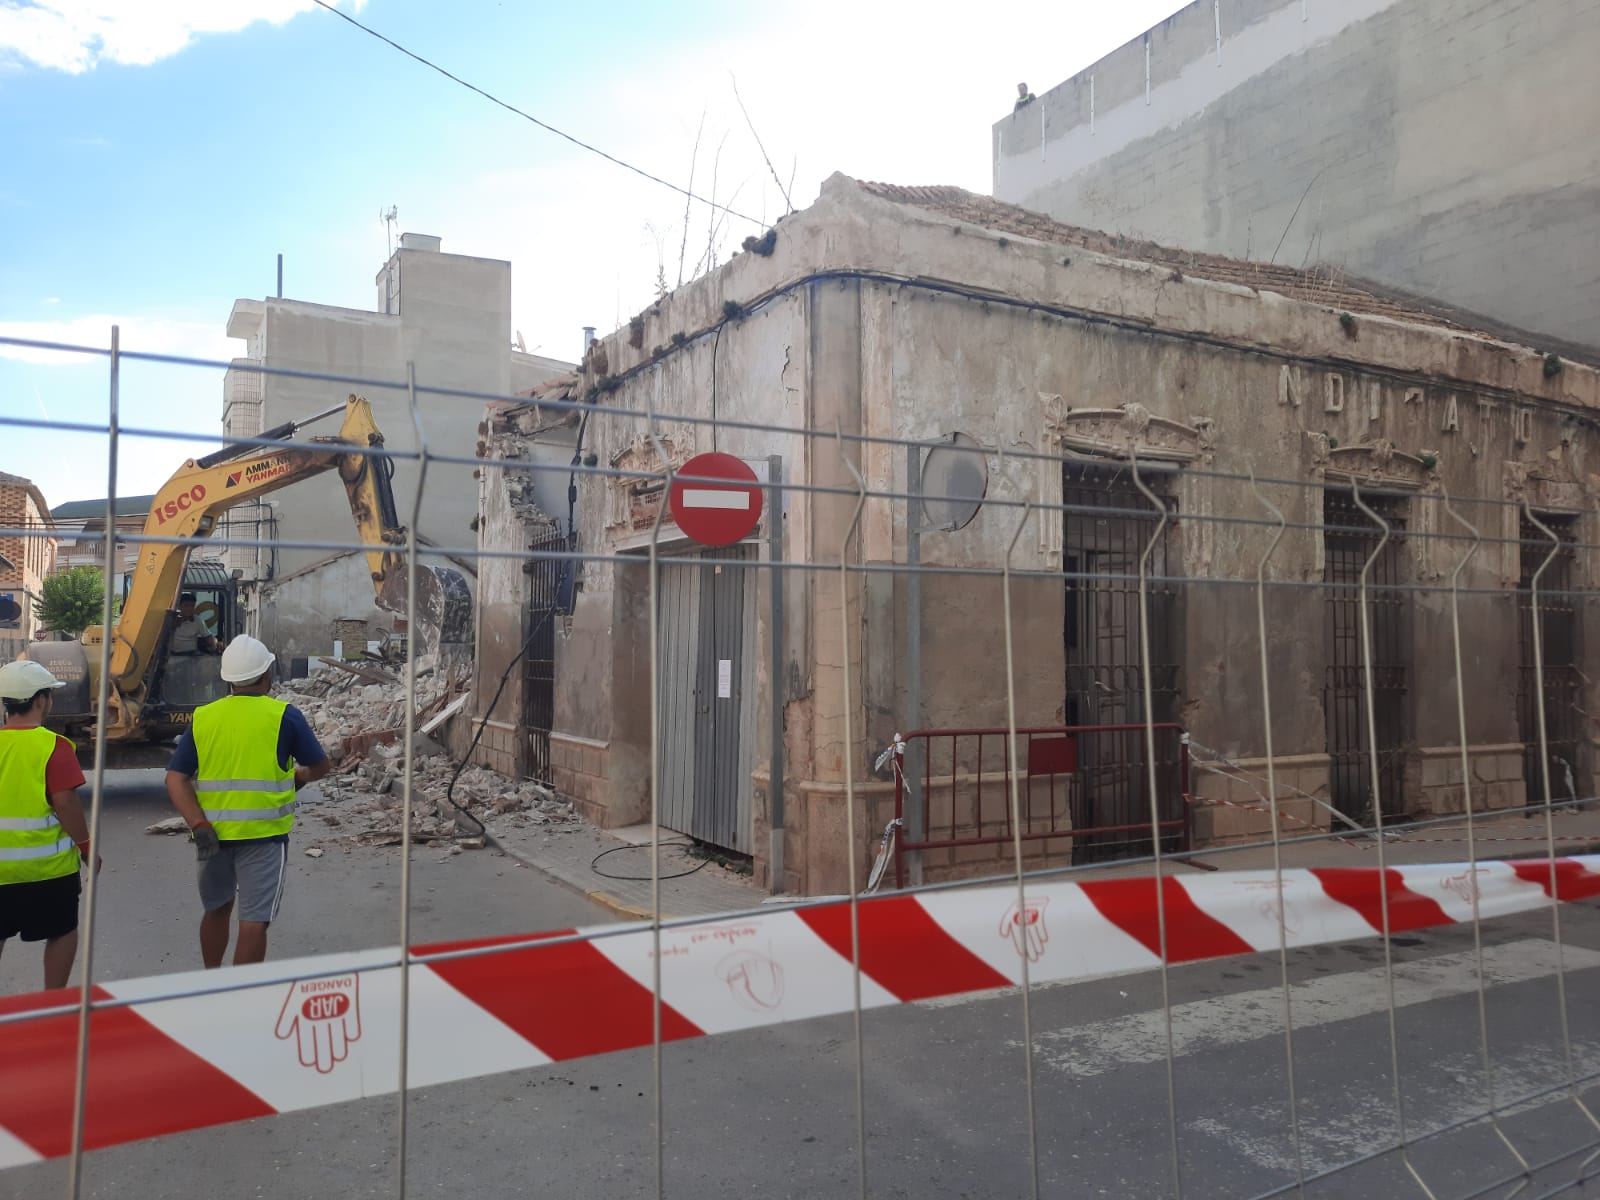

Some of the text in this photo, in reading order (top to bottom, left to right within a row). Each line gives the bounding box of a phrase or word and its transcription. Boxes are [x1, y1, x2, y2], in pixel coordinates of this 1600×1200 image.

[154, 484, 206, 526] ISCO
[300, 977, 352, 993] DANGER
[310, 995, 344, 1018] JAR
